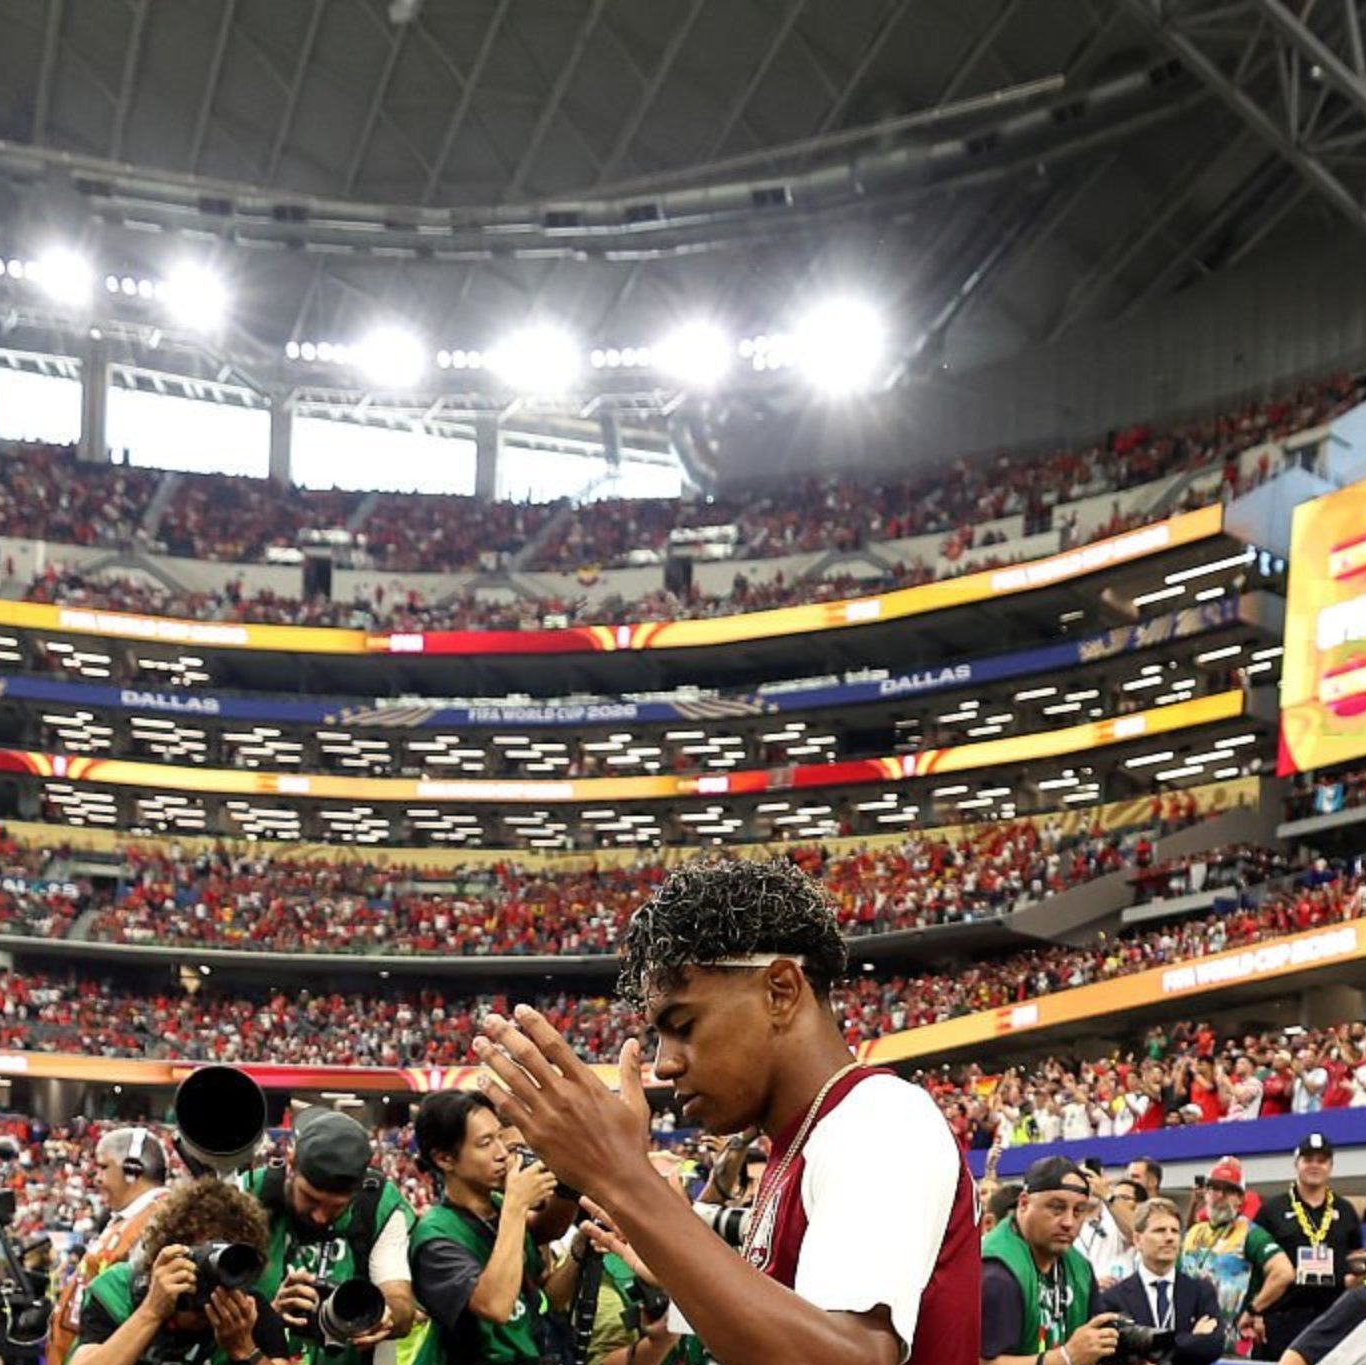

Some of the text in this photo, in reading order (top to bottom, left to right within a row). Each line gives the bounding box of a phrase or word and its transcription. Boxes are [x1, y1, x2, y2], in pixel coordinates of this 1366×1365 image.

[879, 663, 972, 695] DALLAS
[120, 689, 220, 714] DALLAS
[467, 704, 638, 722] FIFA WORLD CUP 2026
